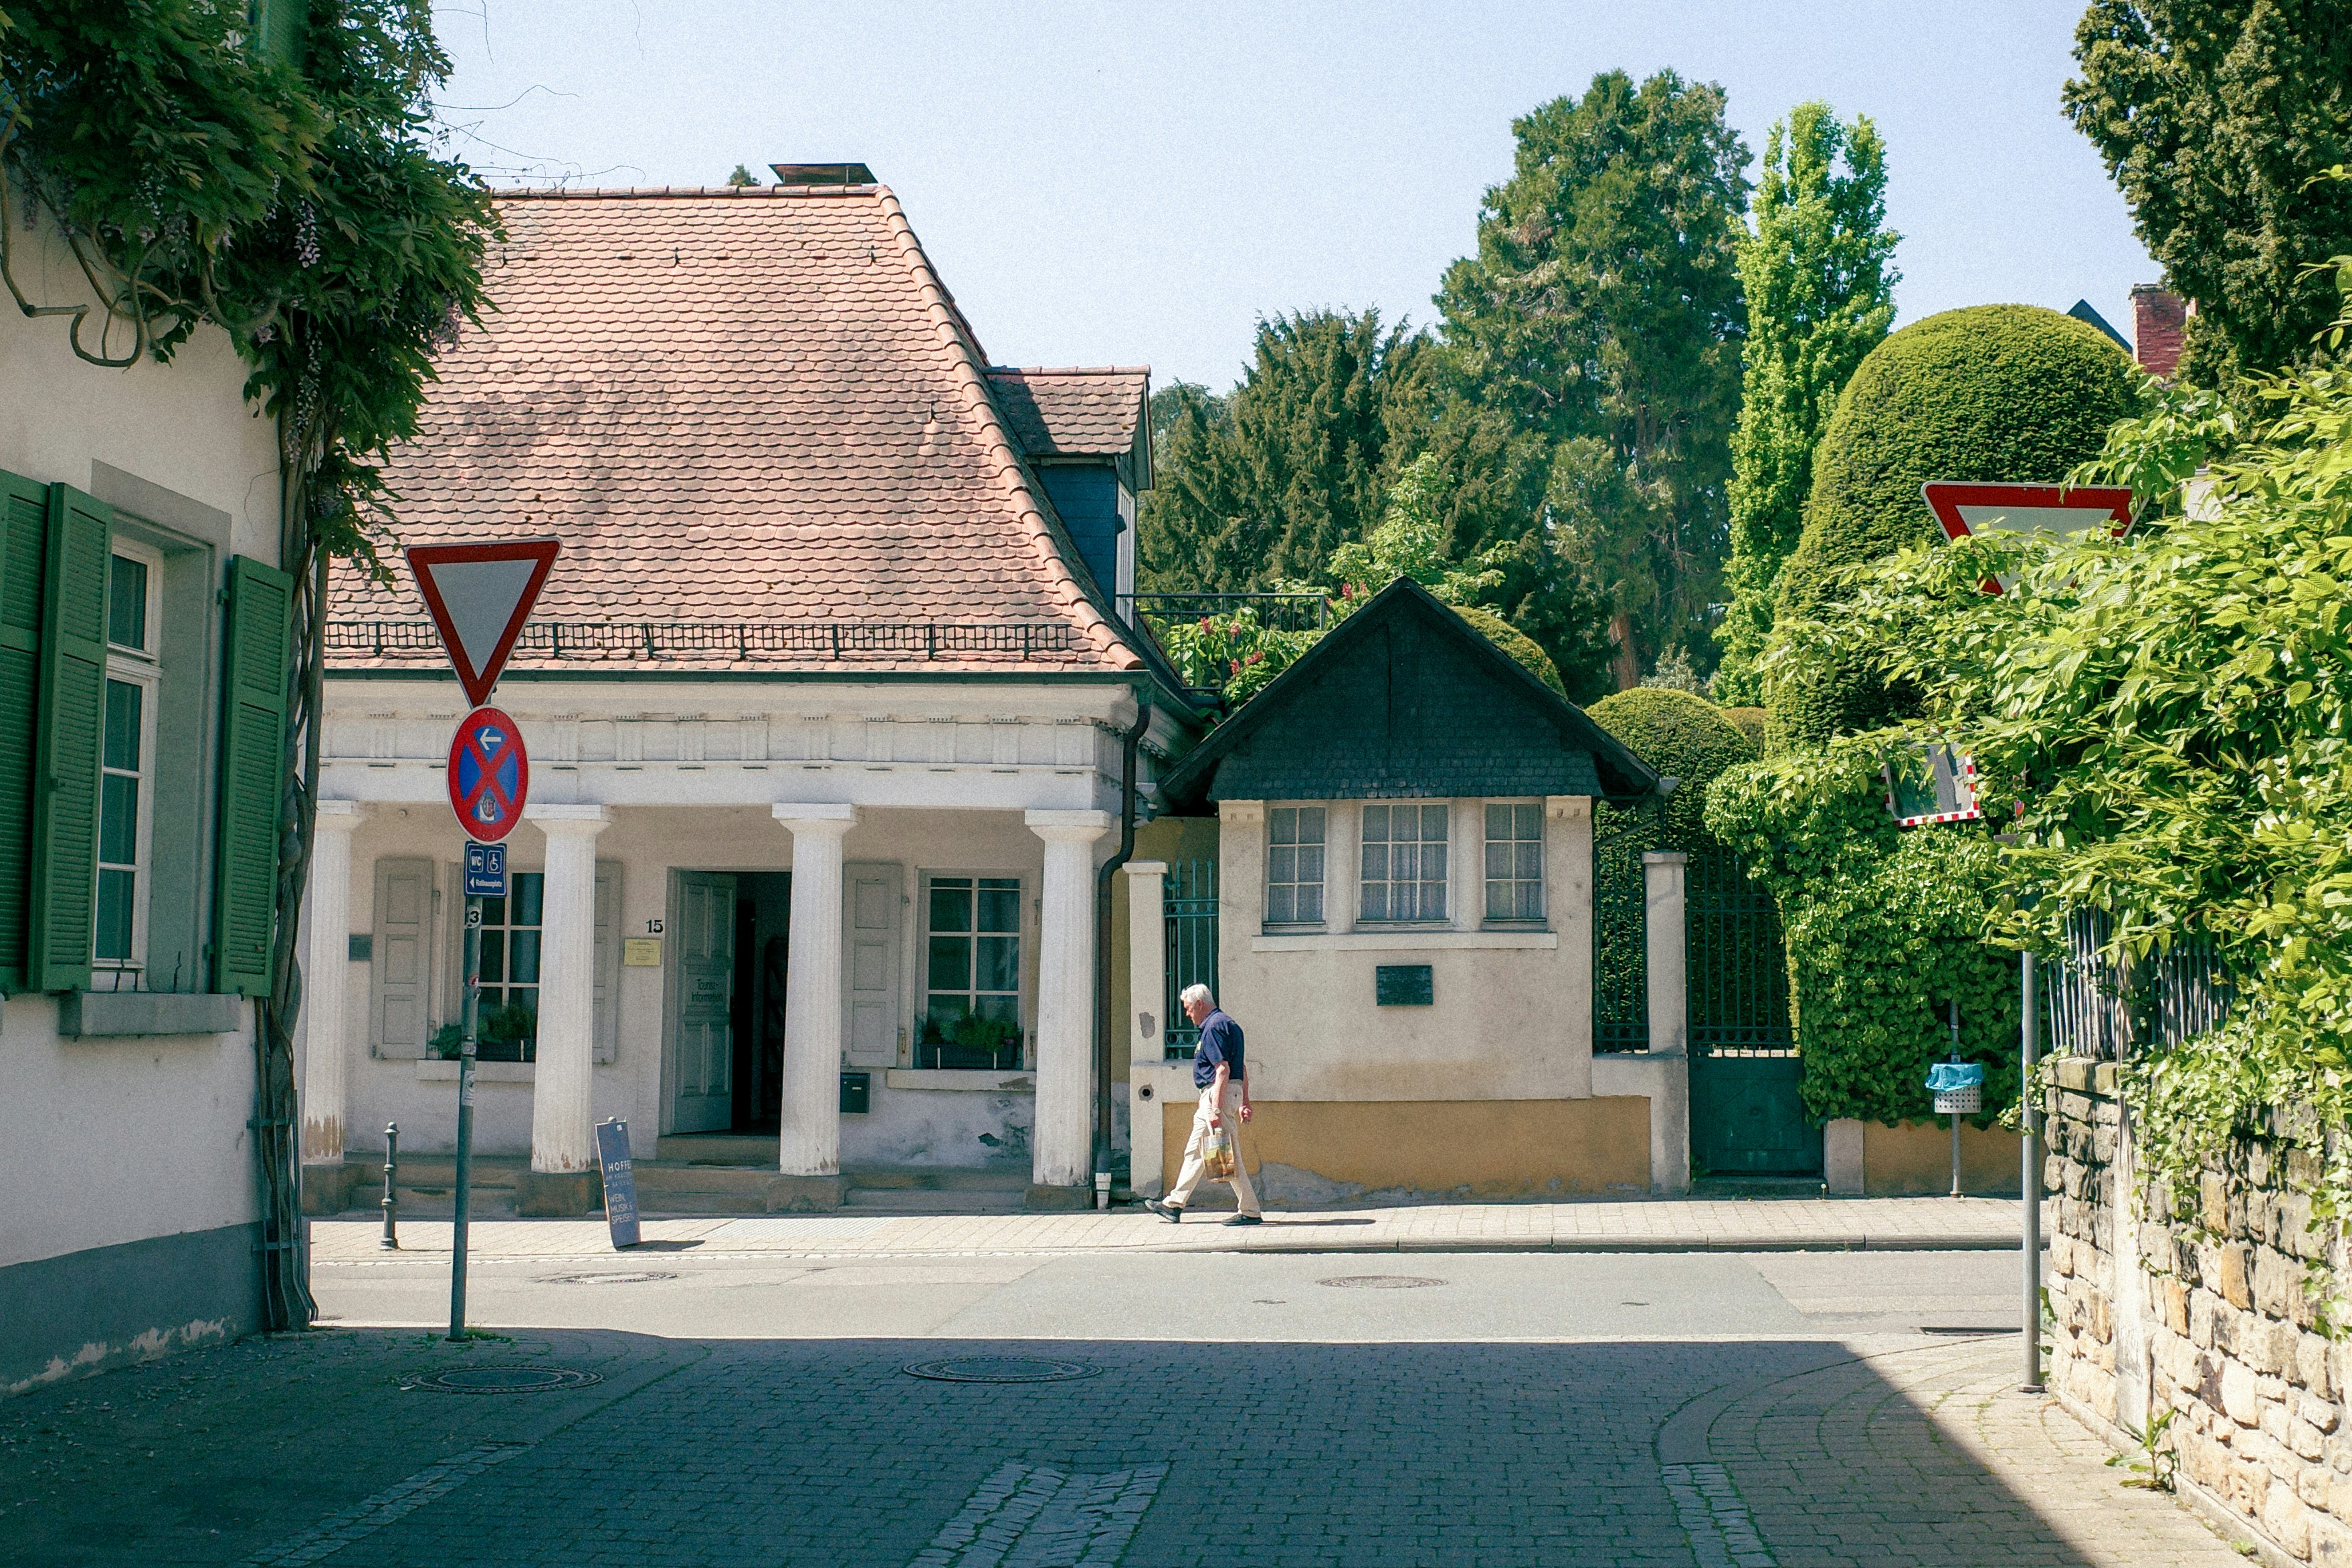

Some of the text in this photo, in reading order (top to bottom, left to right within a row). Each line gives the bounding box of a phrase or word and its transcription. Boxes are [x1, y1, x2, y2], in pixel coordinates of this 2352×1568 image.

[471, 856, 482, 866] WC
[646, 919, 664, 933] 15
[692, 991, 723, 1002] Information
